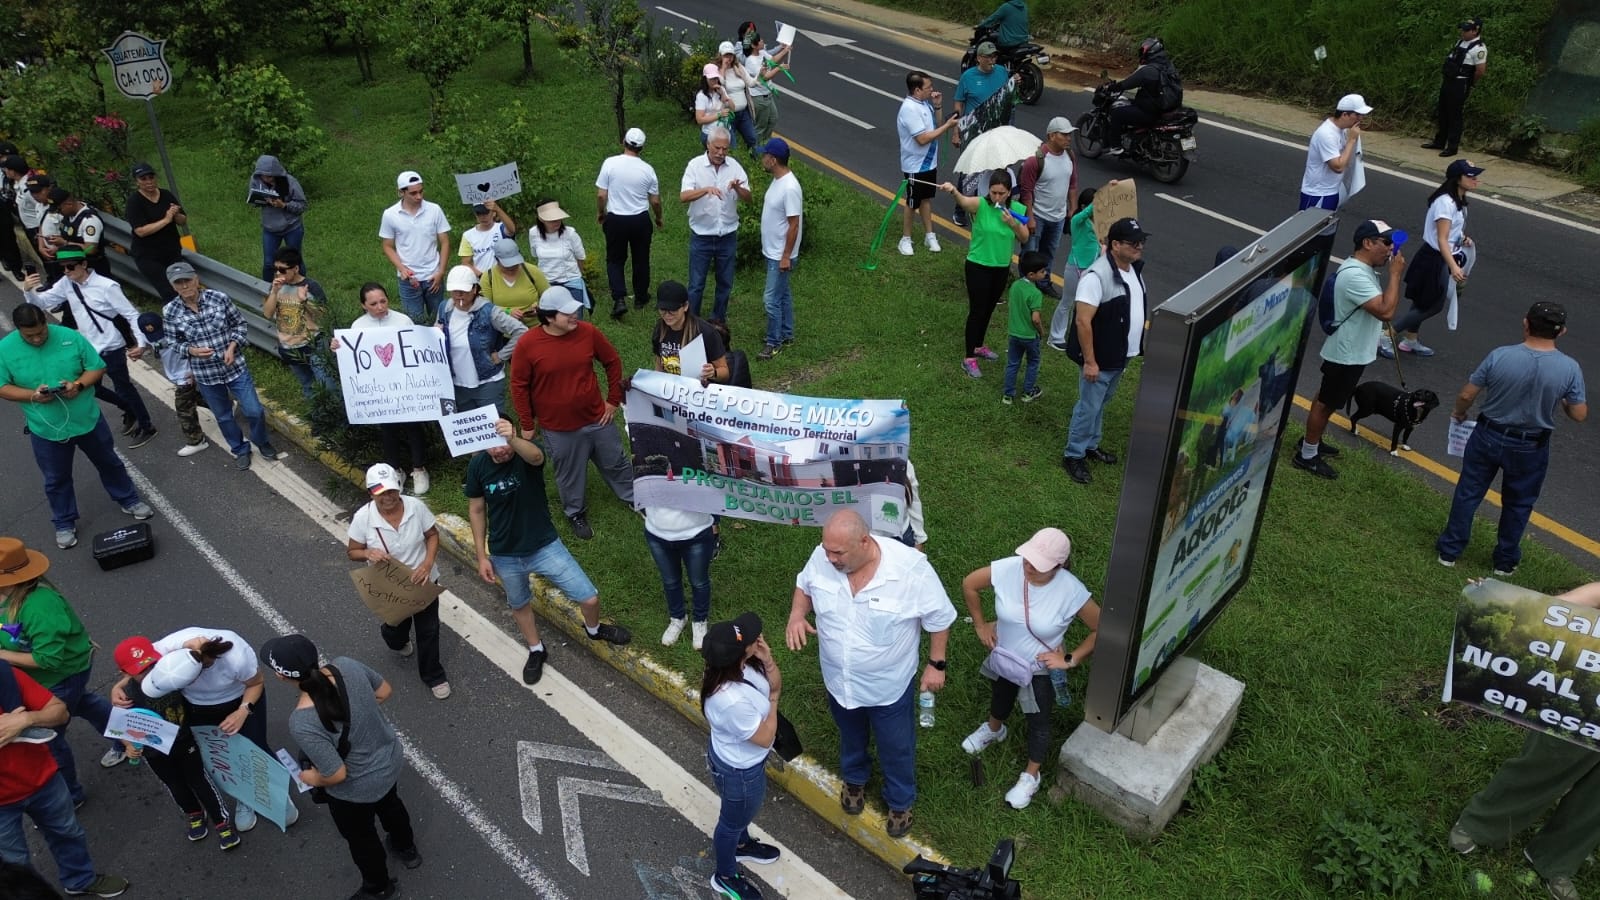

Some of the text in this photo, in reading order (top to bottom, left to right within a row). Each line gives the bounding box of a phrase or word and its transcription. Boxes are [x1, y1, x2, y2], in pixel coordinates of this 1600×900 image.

[113, 47, 158, 62] GUATEMALA
[121, 67, 164, 87] CA-1 OCC
[1263, 287, 1289, 316] Mixco
[341, 329, 448, 374] Yo Encinal
[389, 381, 402, 392] un
[405, 372, 442, 391] Alcalde
[663, 381, 875, 428] URGE POT DE MIXCO
[671, 405, 857, 441] Plan de ordenamiento Territorial
[455, 438, 474, 447] MAS
[681, 466, 859, 506] PROTEJAMOS EL
[724, 494, 815, 522] BOSQUE
[1168, 479, 1251, 577] Adopta
[1528, 640, 1566, 662] el
[1461, 644, 1581, 701] NO AL
[1483, 688, 1600, 740] en esa
